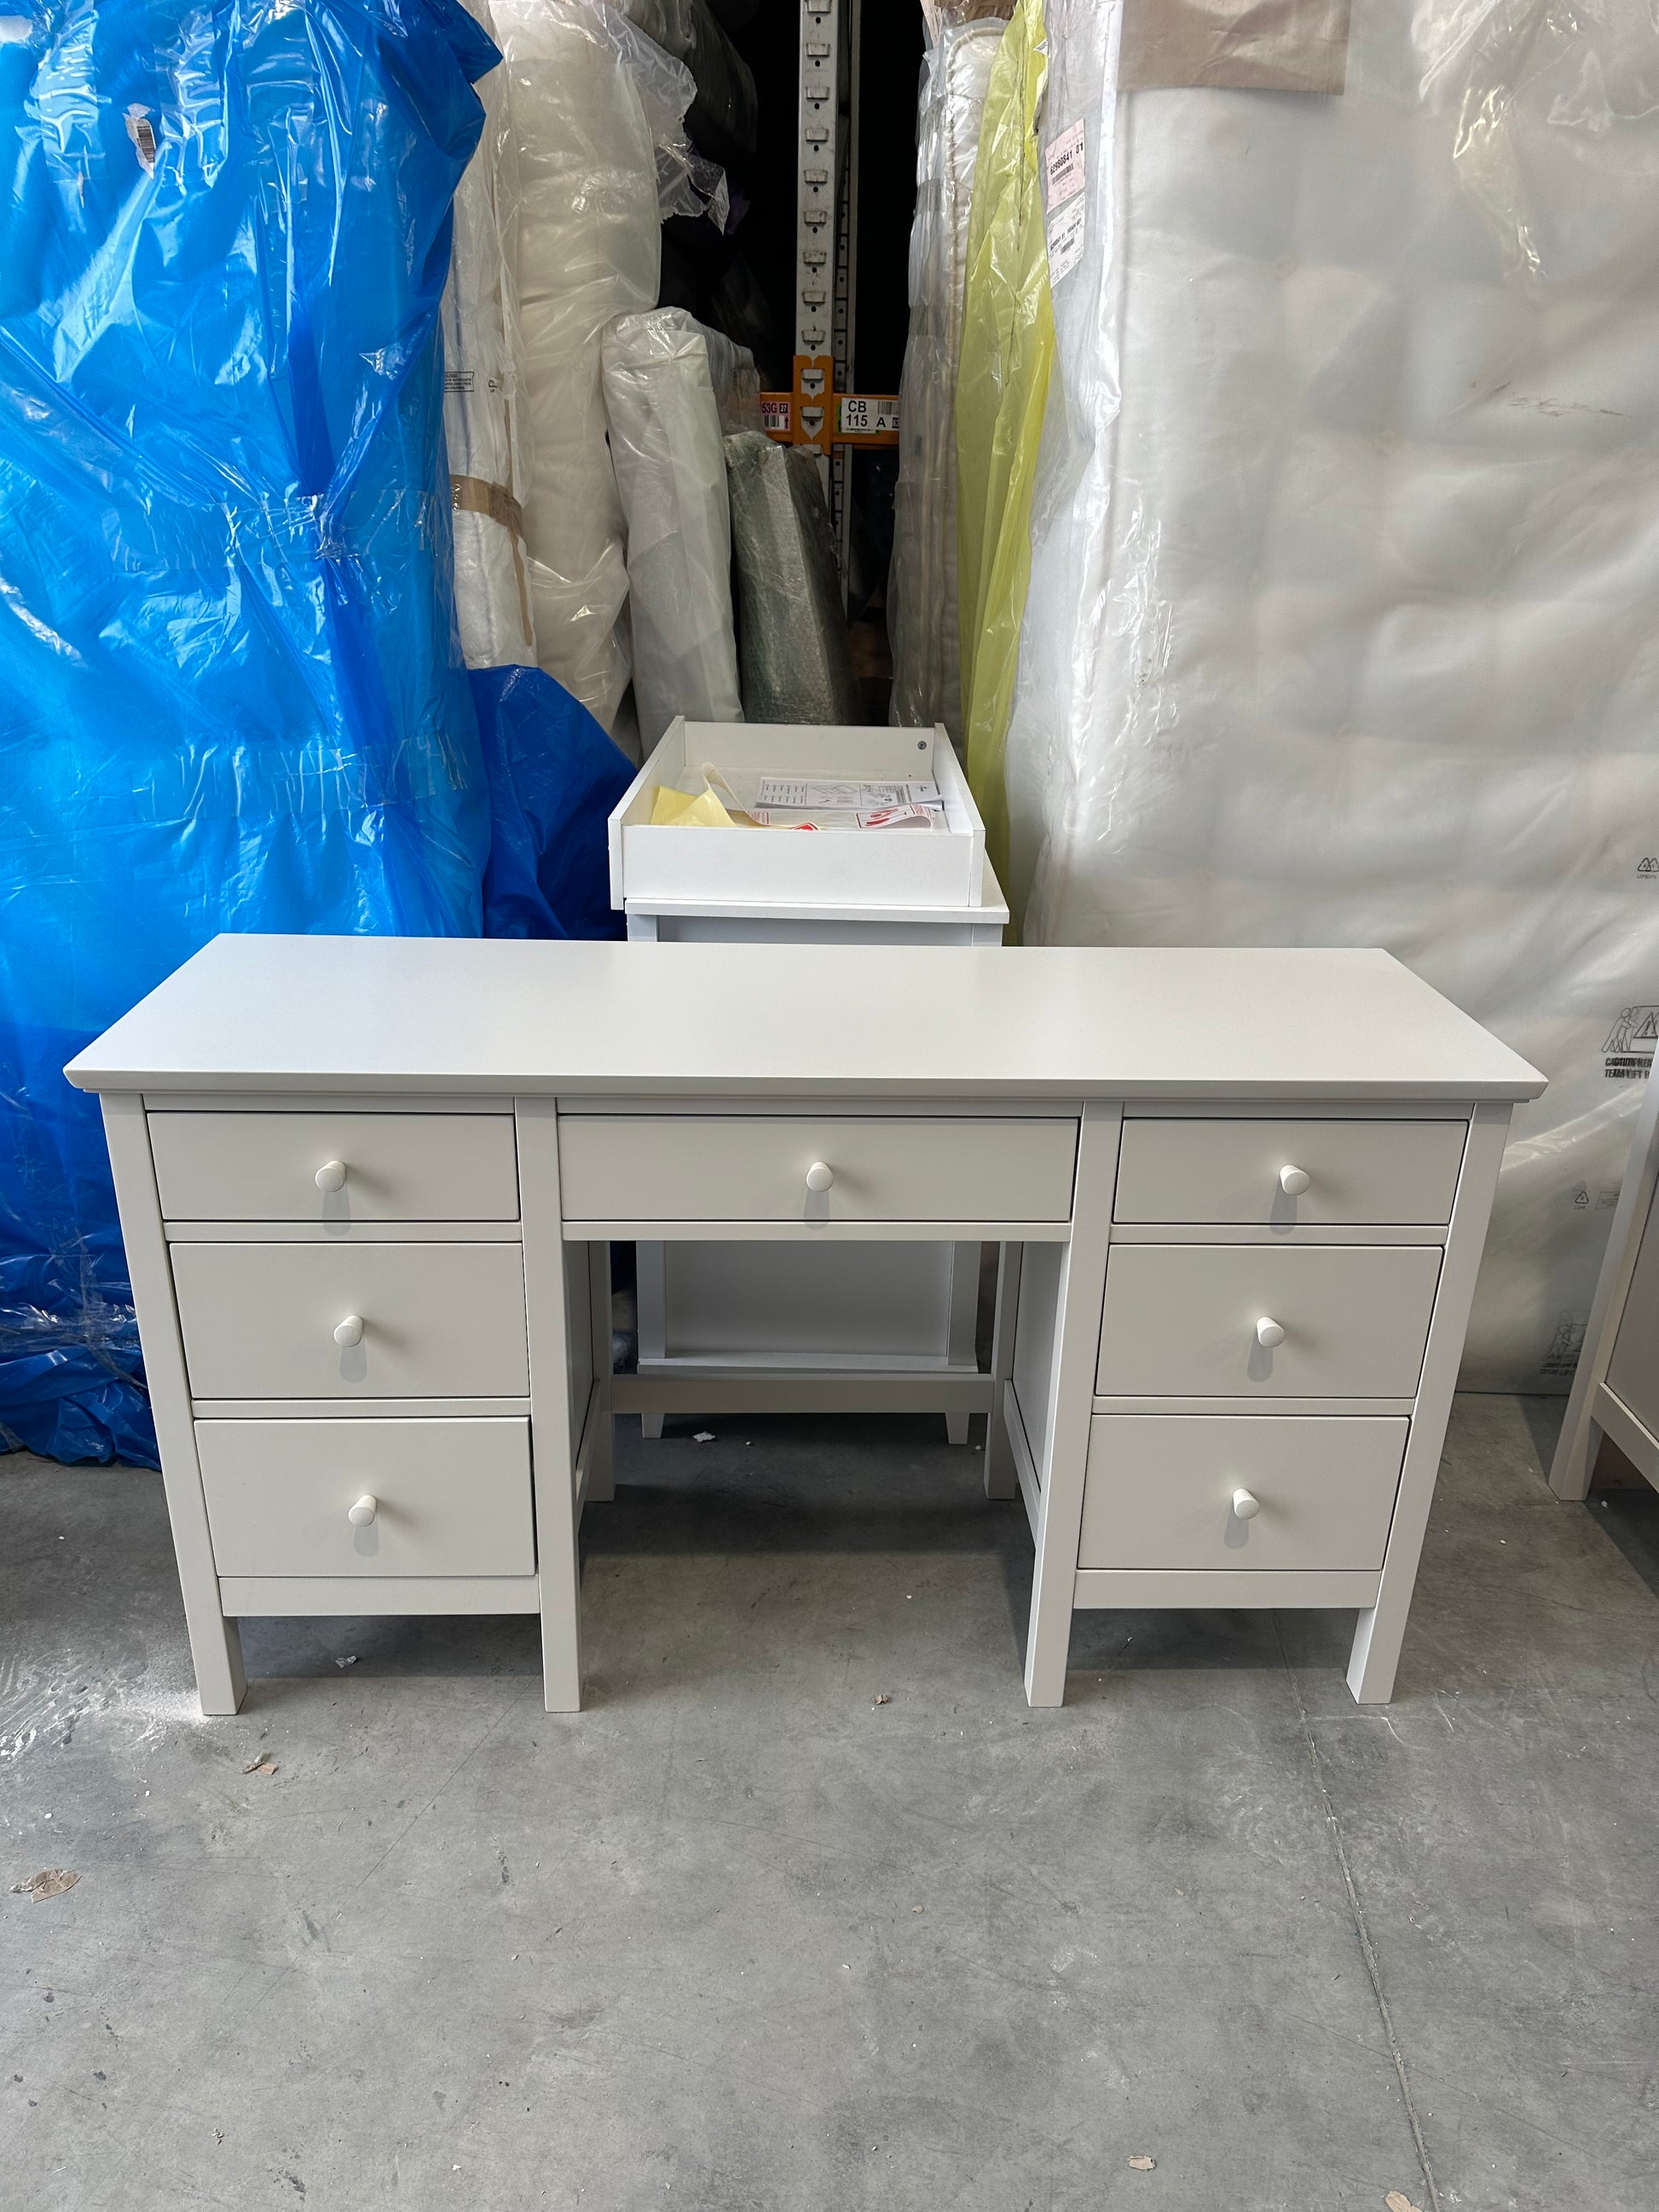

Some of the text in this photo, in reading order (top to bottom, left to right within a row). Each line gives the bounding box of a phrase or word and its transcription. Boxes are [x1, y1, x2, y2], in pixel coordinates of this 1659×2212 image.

[848, 400, 867, 413] CB
[847, 414, 868, 427] 115
[876, 417, 886, 428] A
